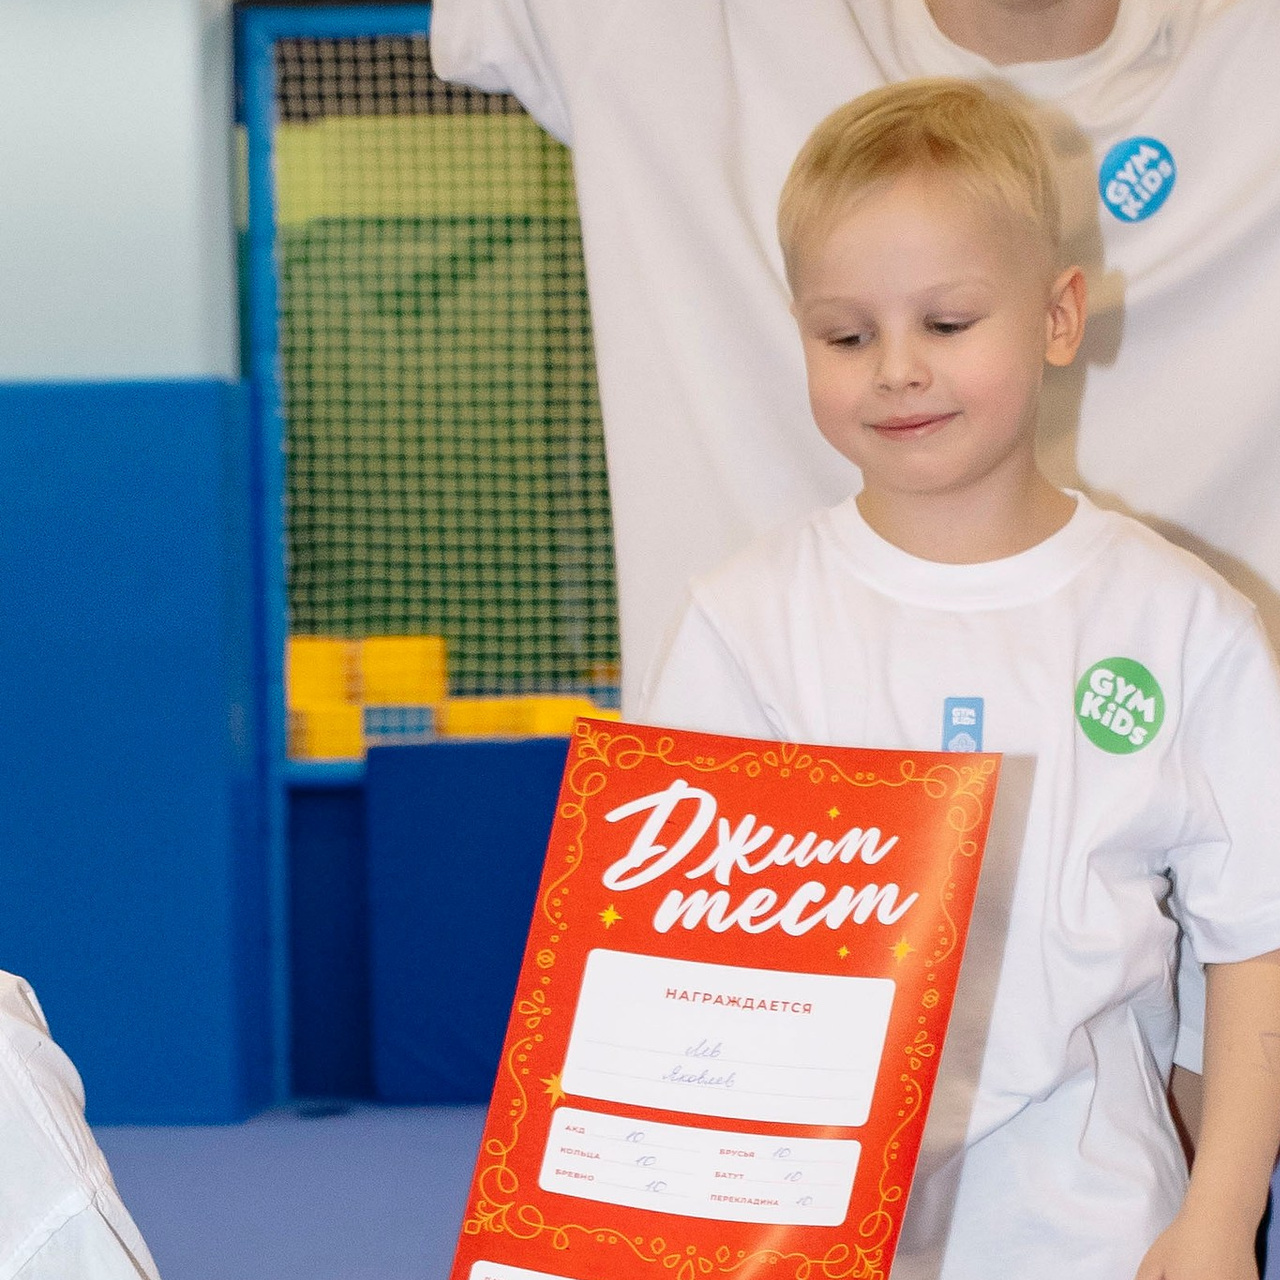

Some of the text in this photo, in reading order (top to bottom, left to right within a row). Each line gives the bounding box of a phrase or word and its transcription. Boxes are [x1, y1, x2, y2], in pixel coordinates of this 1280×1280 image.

[1106, 145, 1160, 205] GYM
[1089, 668, 1156, 723] GYM
[602, 778, 900, 892] Джим
[653, 880, 920, 937] тест
[665, 987, 813, 1015] НАГРАЖДАЕТСЯ
[626, 1131, 646, 1144] 10
[560, 1147, 601, 1160] КОЛЬЦА
[773, 1147, 792, 1158] 10
[635, 1155, 657, 1167] 10
[555, 1168, 595, 1182] БРЕВНО
[714, 1170, 745, 1180] БАТУТ
[784, 1171, 803, 1182] 10
[644, 1180, 668, 1193] 10
[710, 1193, 780, 1207] ПЕРЕКЛАДИНА
[796, 1195, 814, 1207] 10
